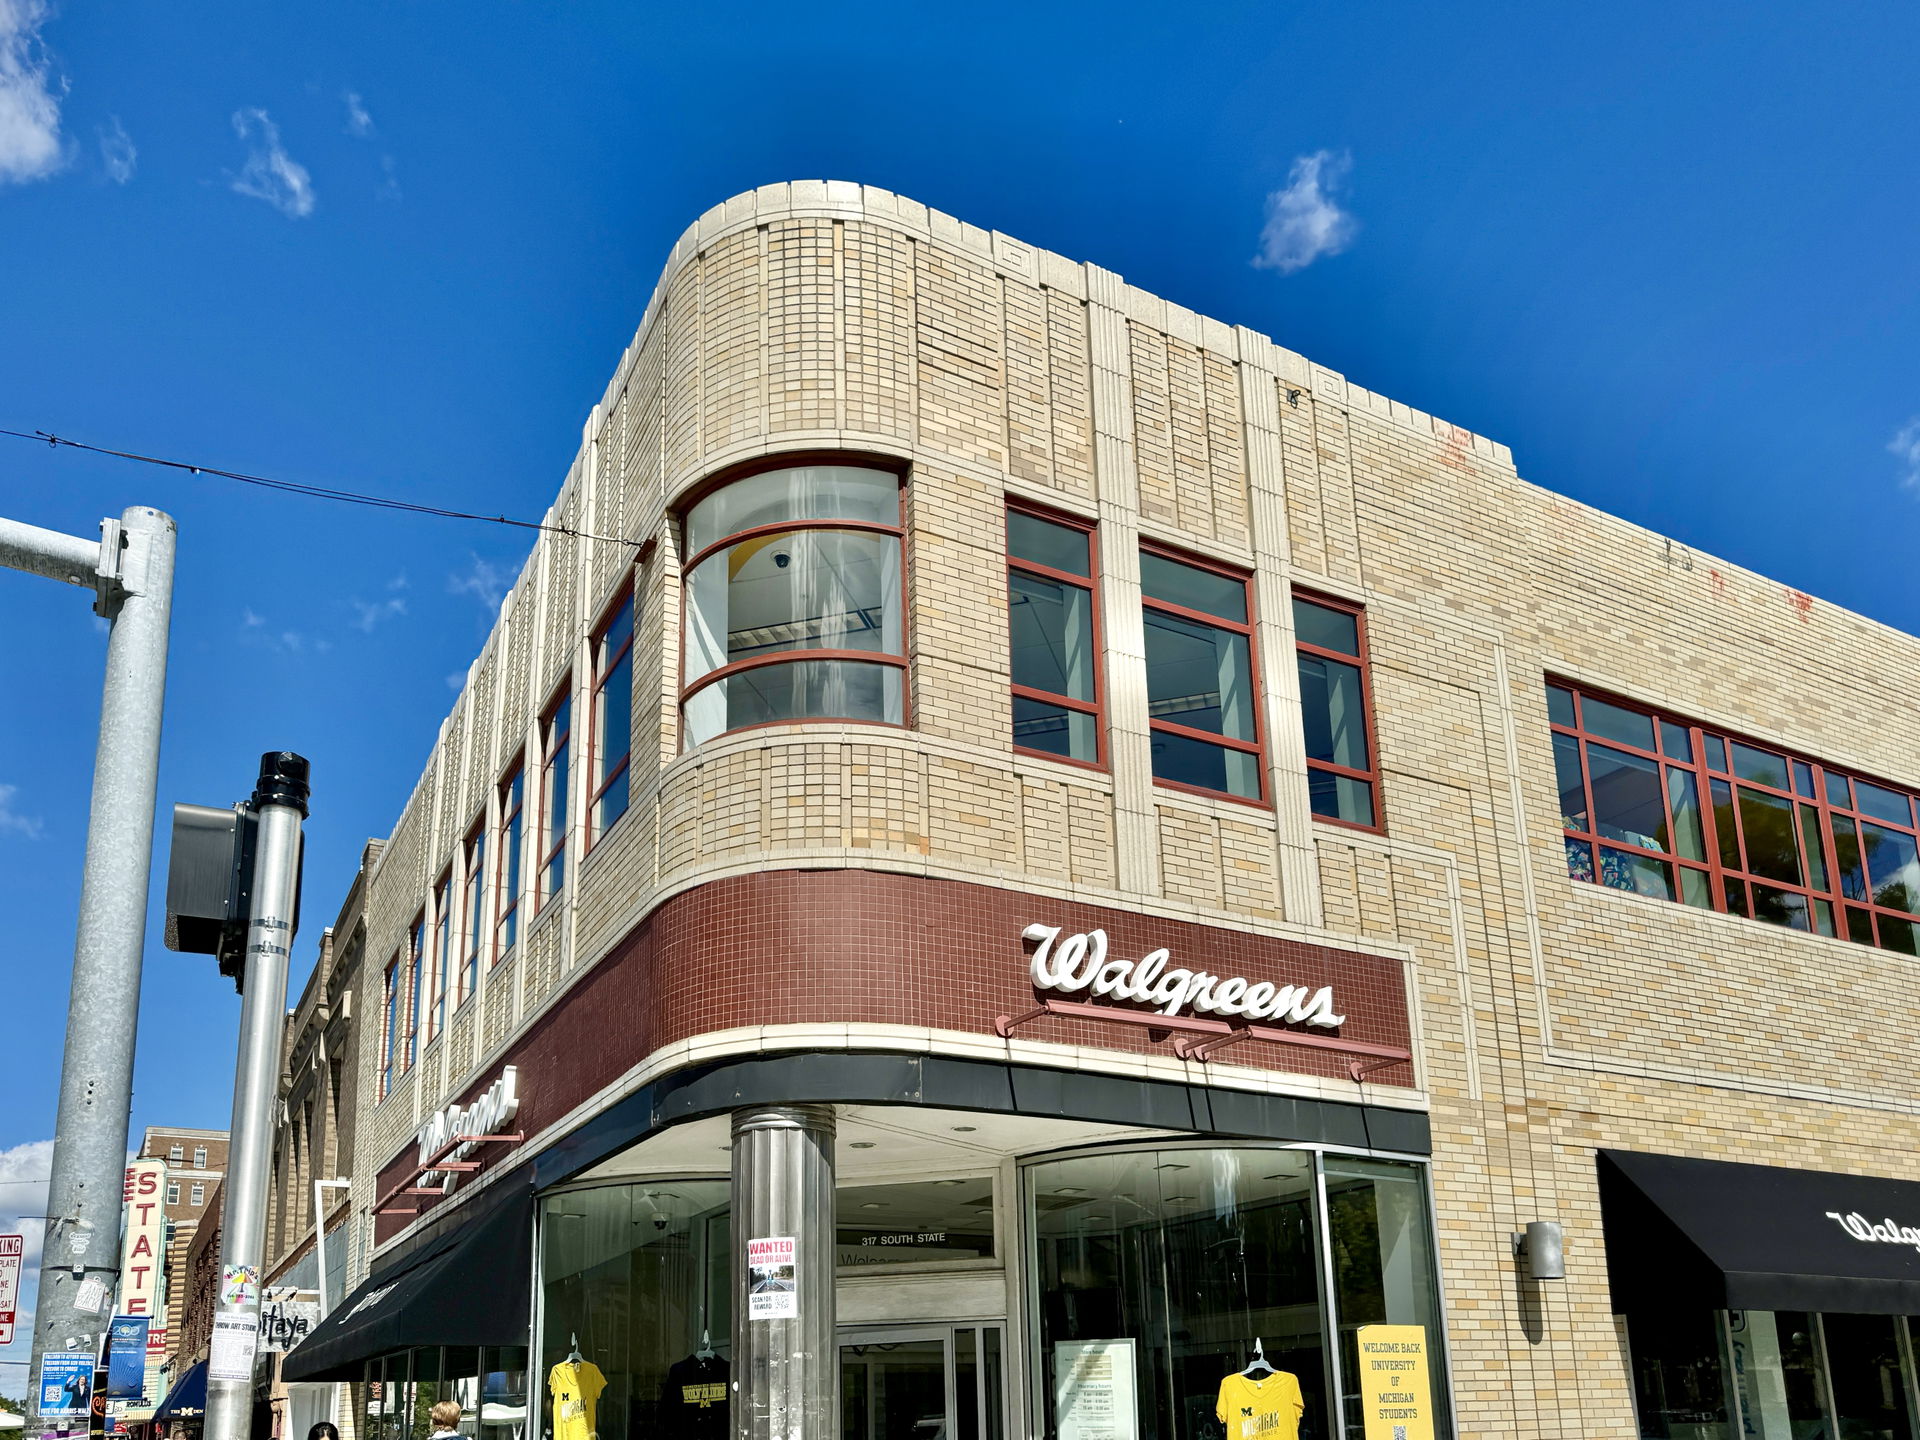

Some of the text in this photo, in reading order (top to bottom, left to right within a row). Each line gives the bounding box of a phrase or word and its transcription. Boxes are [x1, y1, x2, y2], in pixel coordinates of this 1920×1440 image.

[1021, 923, 1345, 1028] Walgreens
[128, 1172, 157, 1314] STATE
[862, 1232, 946, 1246] 317 SOUTH STATE
[749, 1241, 793, 1255] WANTED
[750, 1254, 792, 1265] DEAD OR ALIVE
[260, 1305, 309, 1352] itaya
[1363, 1342, 1421, 1353] WELCOME BACK
[1371, 1360, 1416, 1371] UNIVERSITY
[1391, 1376, 1400, 1386] OF
[562, 1392, 569, 1401] M
[1378, 1393, 1414, 1403] MICHIGAN
[1379, 1408, 1418, 1419] STUDENTS
